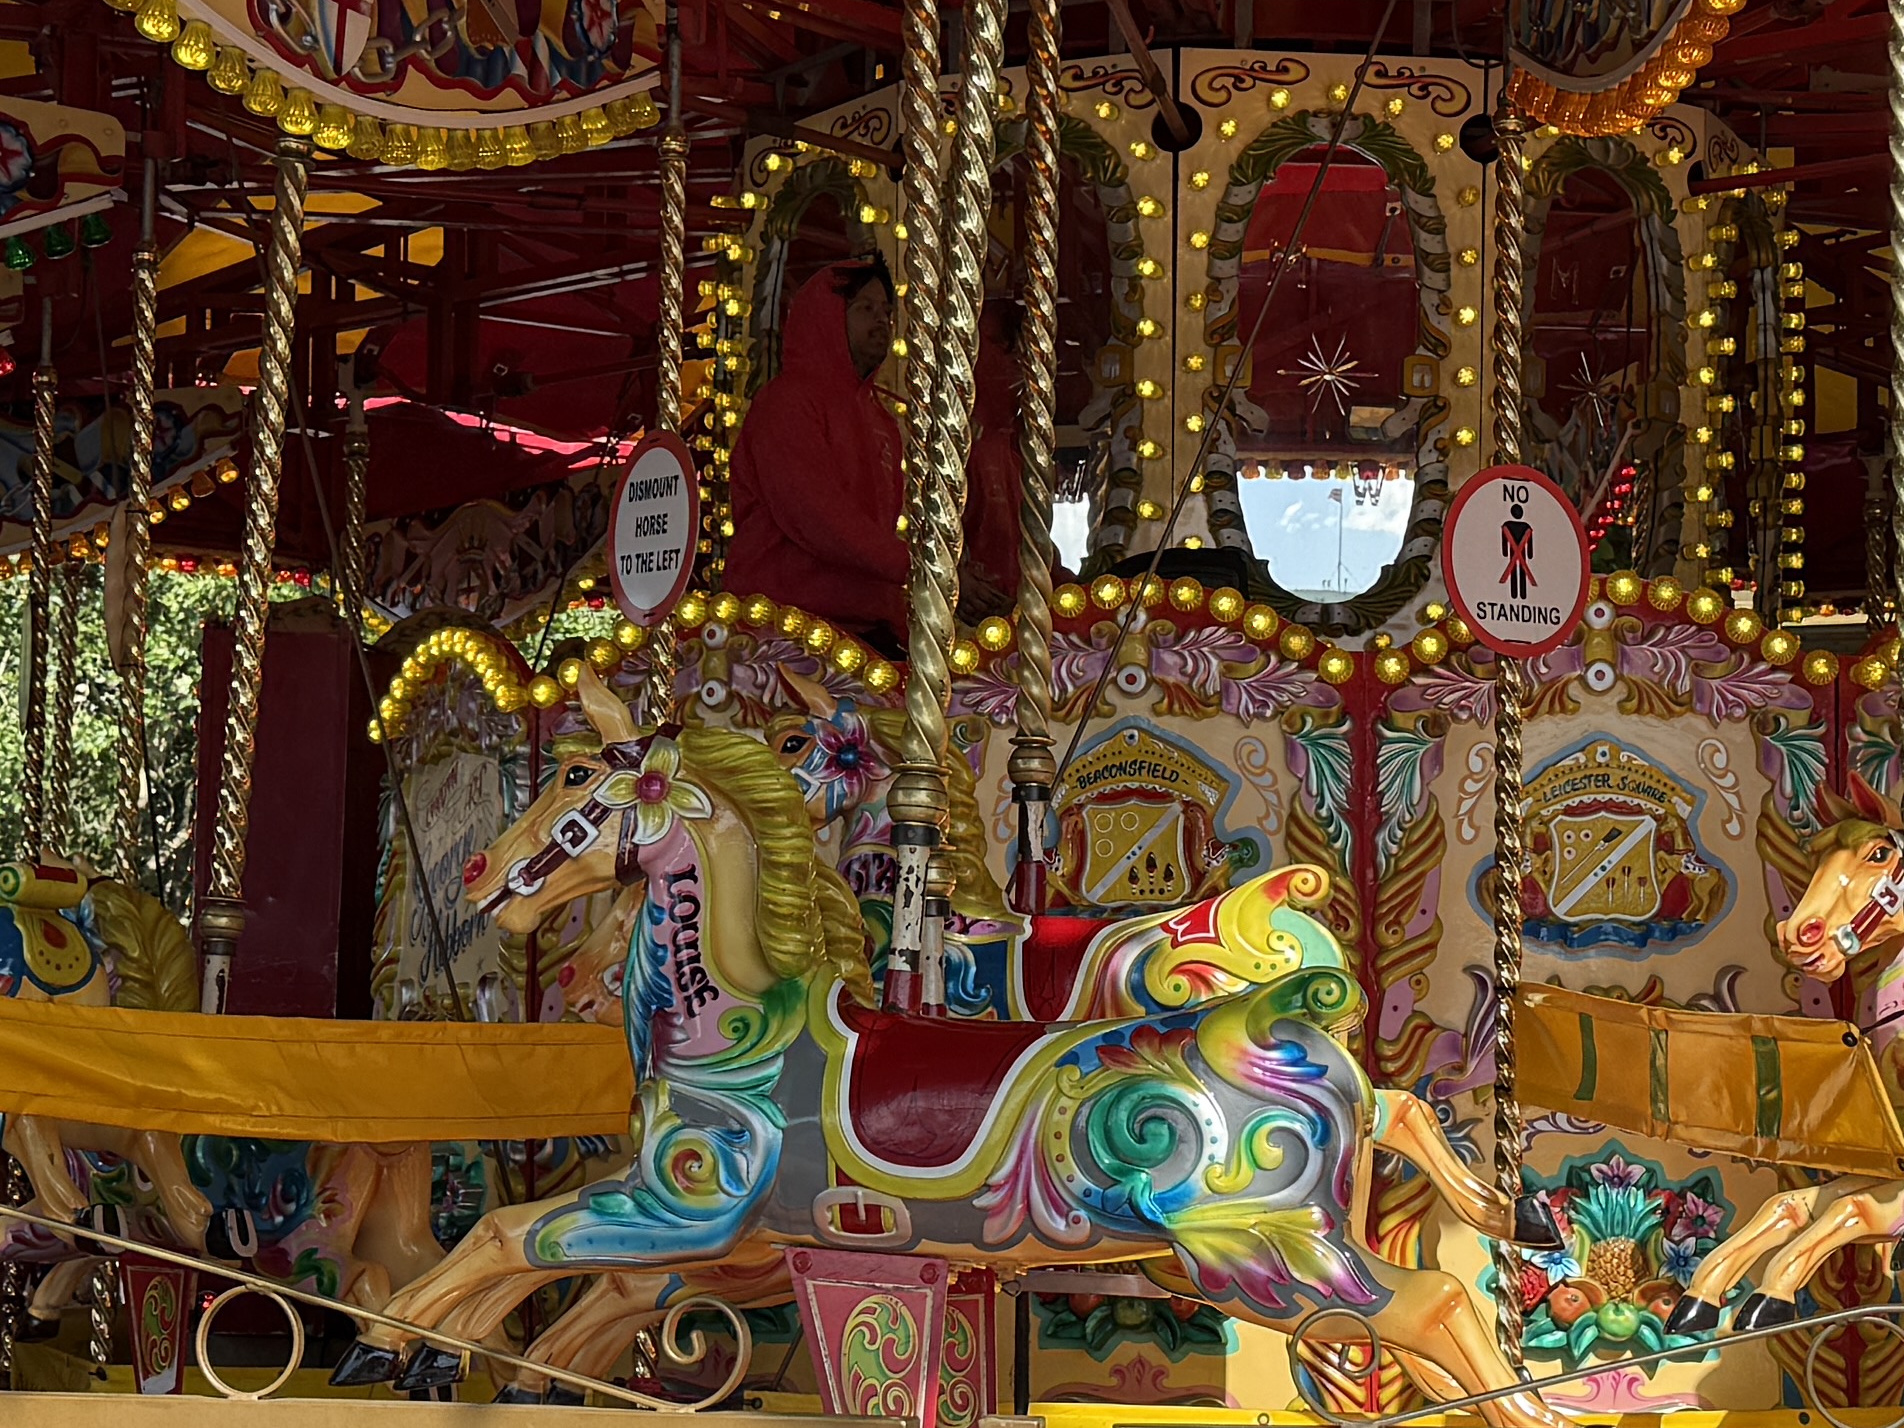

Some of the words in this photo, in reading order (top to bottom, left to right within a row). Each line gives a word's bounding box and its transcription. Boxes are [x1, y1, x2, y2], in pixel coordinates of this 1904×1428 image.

[628, 474, 680, 503] DISMOUNT
[1502, 483, 1530, 504] NO
[634, 513, 669, 538] HORSE
[620, 554, 633, 576] TO
[635, 550, 655, 574] THE
[656, 548, 681, 572] LEFT
[1476, 601, 1561, 626] STANDING
[1076, 759, 1180, 790] BEACONSFIELD
[1542, 773, 1612, 804] LEICESTER
[1616, 775, 1668, 805] SQUARE
[663, 862, 720, 1020] LOUISE
